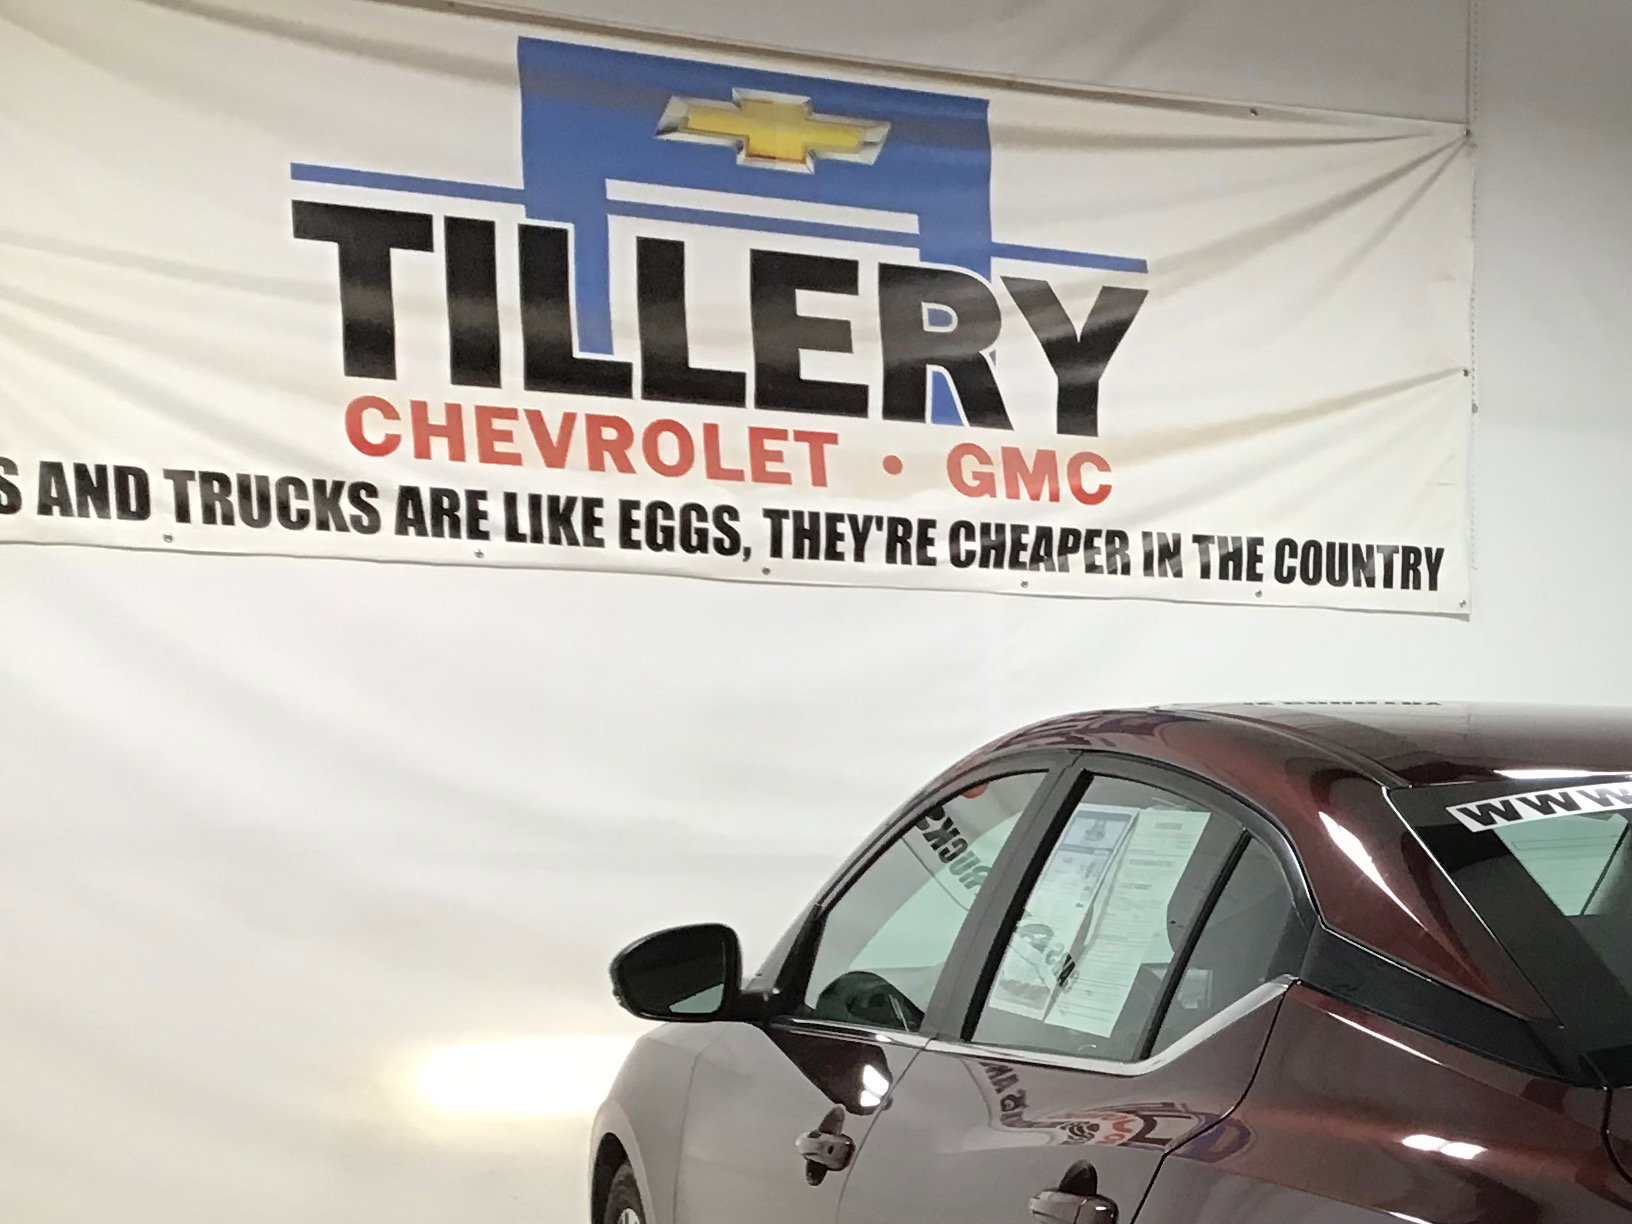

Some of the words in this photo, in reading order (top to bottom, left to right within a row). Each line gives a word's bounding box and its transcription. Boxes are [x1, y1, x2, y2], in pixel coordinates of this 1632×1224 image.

[292, 200, 1149, 438] TILLERY
[345, 395, 839, 488] CHEVROLET
[946, 443, 1112, 505] GMC
[37, 460, 151, 521] AND
[163, 469, 381, 535] TRUCKS
[394, 486, 490, 542] ARE
[504, 492, 605, 548] LIKE
[618, 500, 752, 562] EGGS,
[762, 508, 938, 567] THEY'RE
[949, 520, 1131, 577] CHEAPER
[1141, 530, 1184, 578] IN
[1191, 533, 1265, 583] THE
[1274, 537, 1446, 591] COUNTRY
